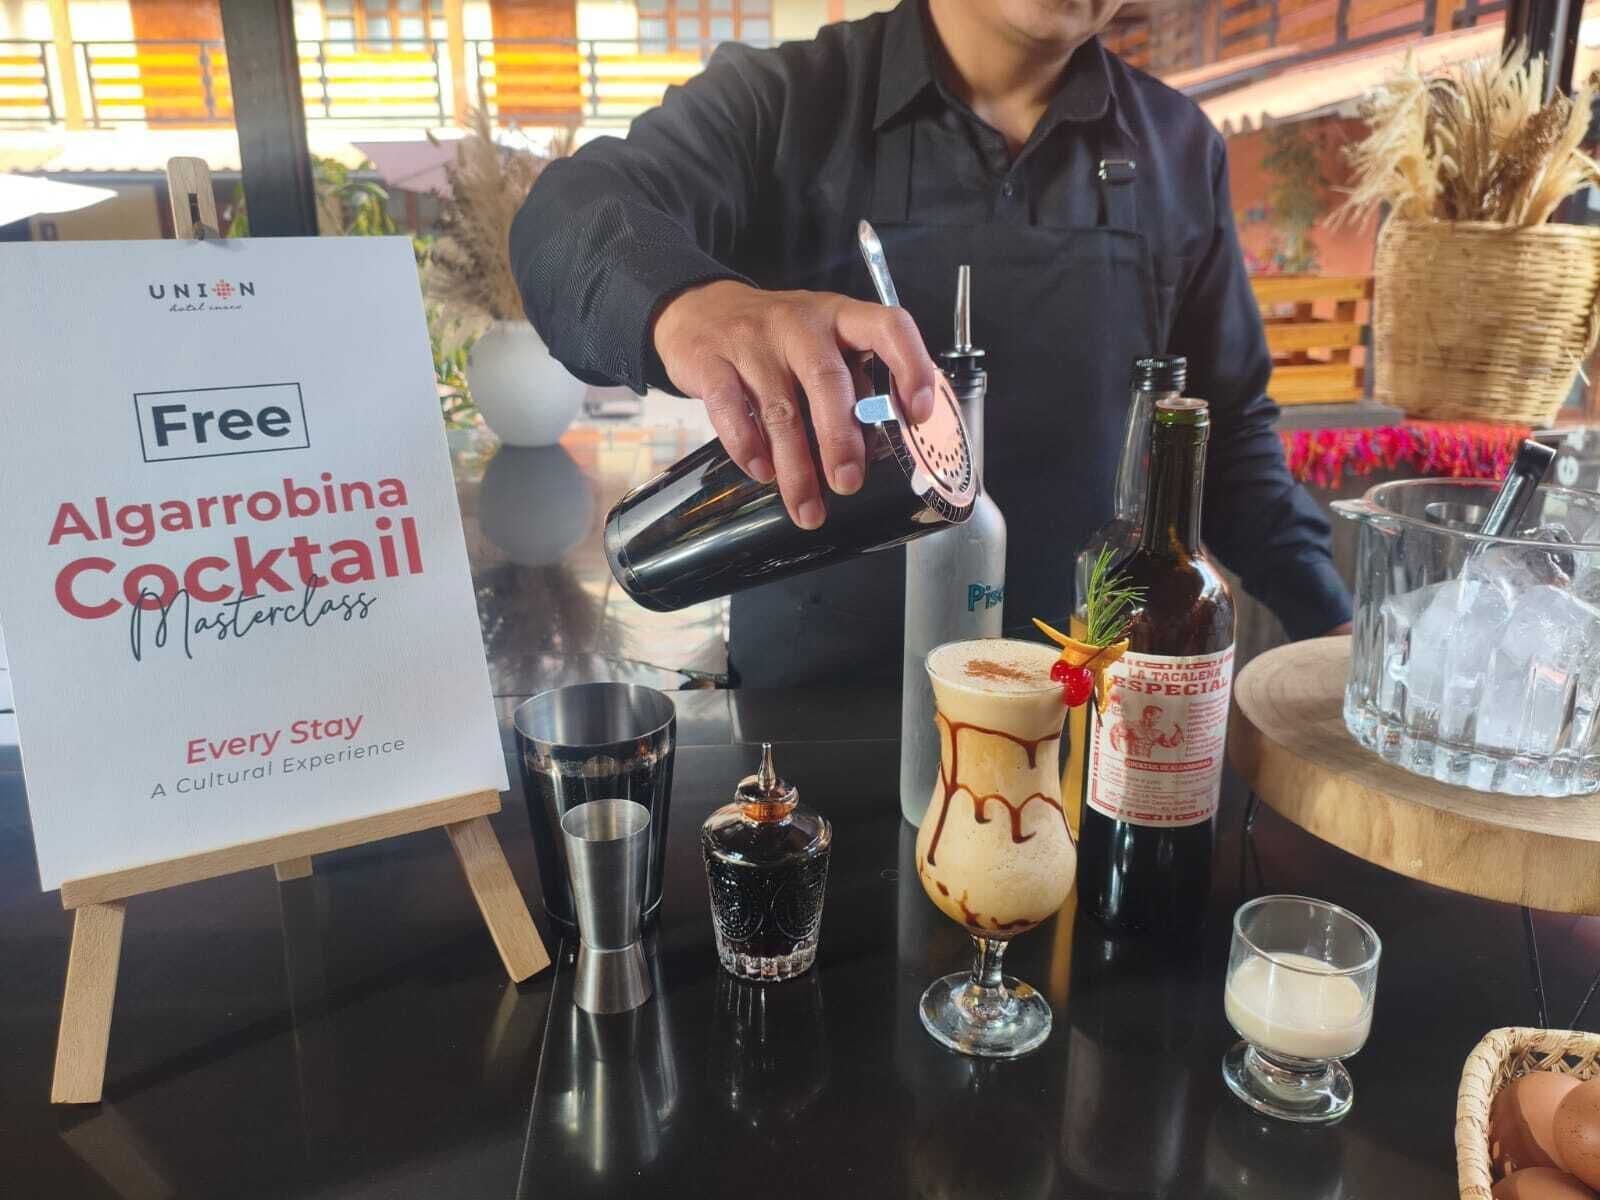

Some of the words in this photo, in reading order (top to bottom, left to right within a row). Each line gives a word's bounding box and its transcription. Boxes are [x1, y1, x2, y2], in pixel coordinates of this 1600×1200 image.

[169, 302, 206, 312] hotel
[151, 404, 292, 447] Free
[48, 472, 408, 547] Algarrobina
[54, 516, 424, 620] Cocktail
[130, 573, 376, 661] Masterclass
[1112, 676, 1227, 696] ESPECIAL
[186, 729, 282, 765] Every
[291, 714, 364, 749] Stay
[151, 782, 167, 800] A
[176, 760, 273, 795] Cultural
[282, 737, 406, 775] Experience
